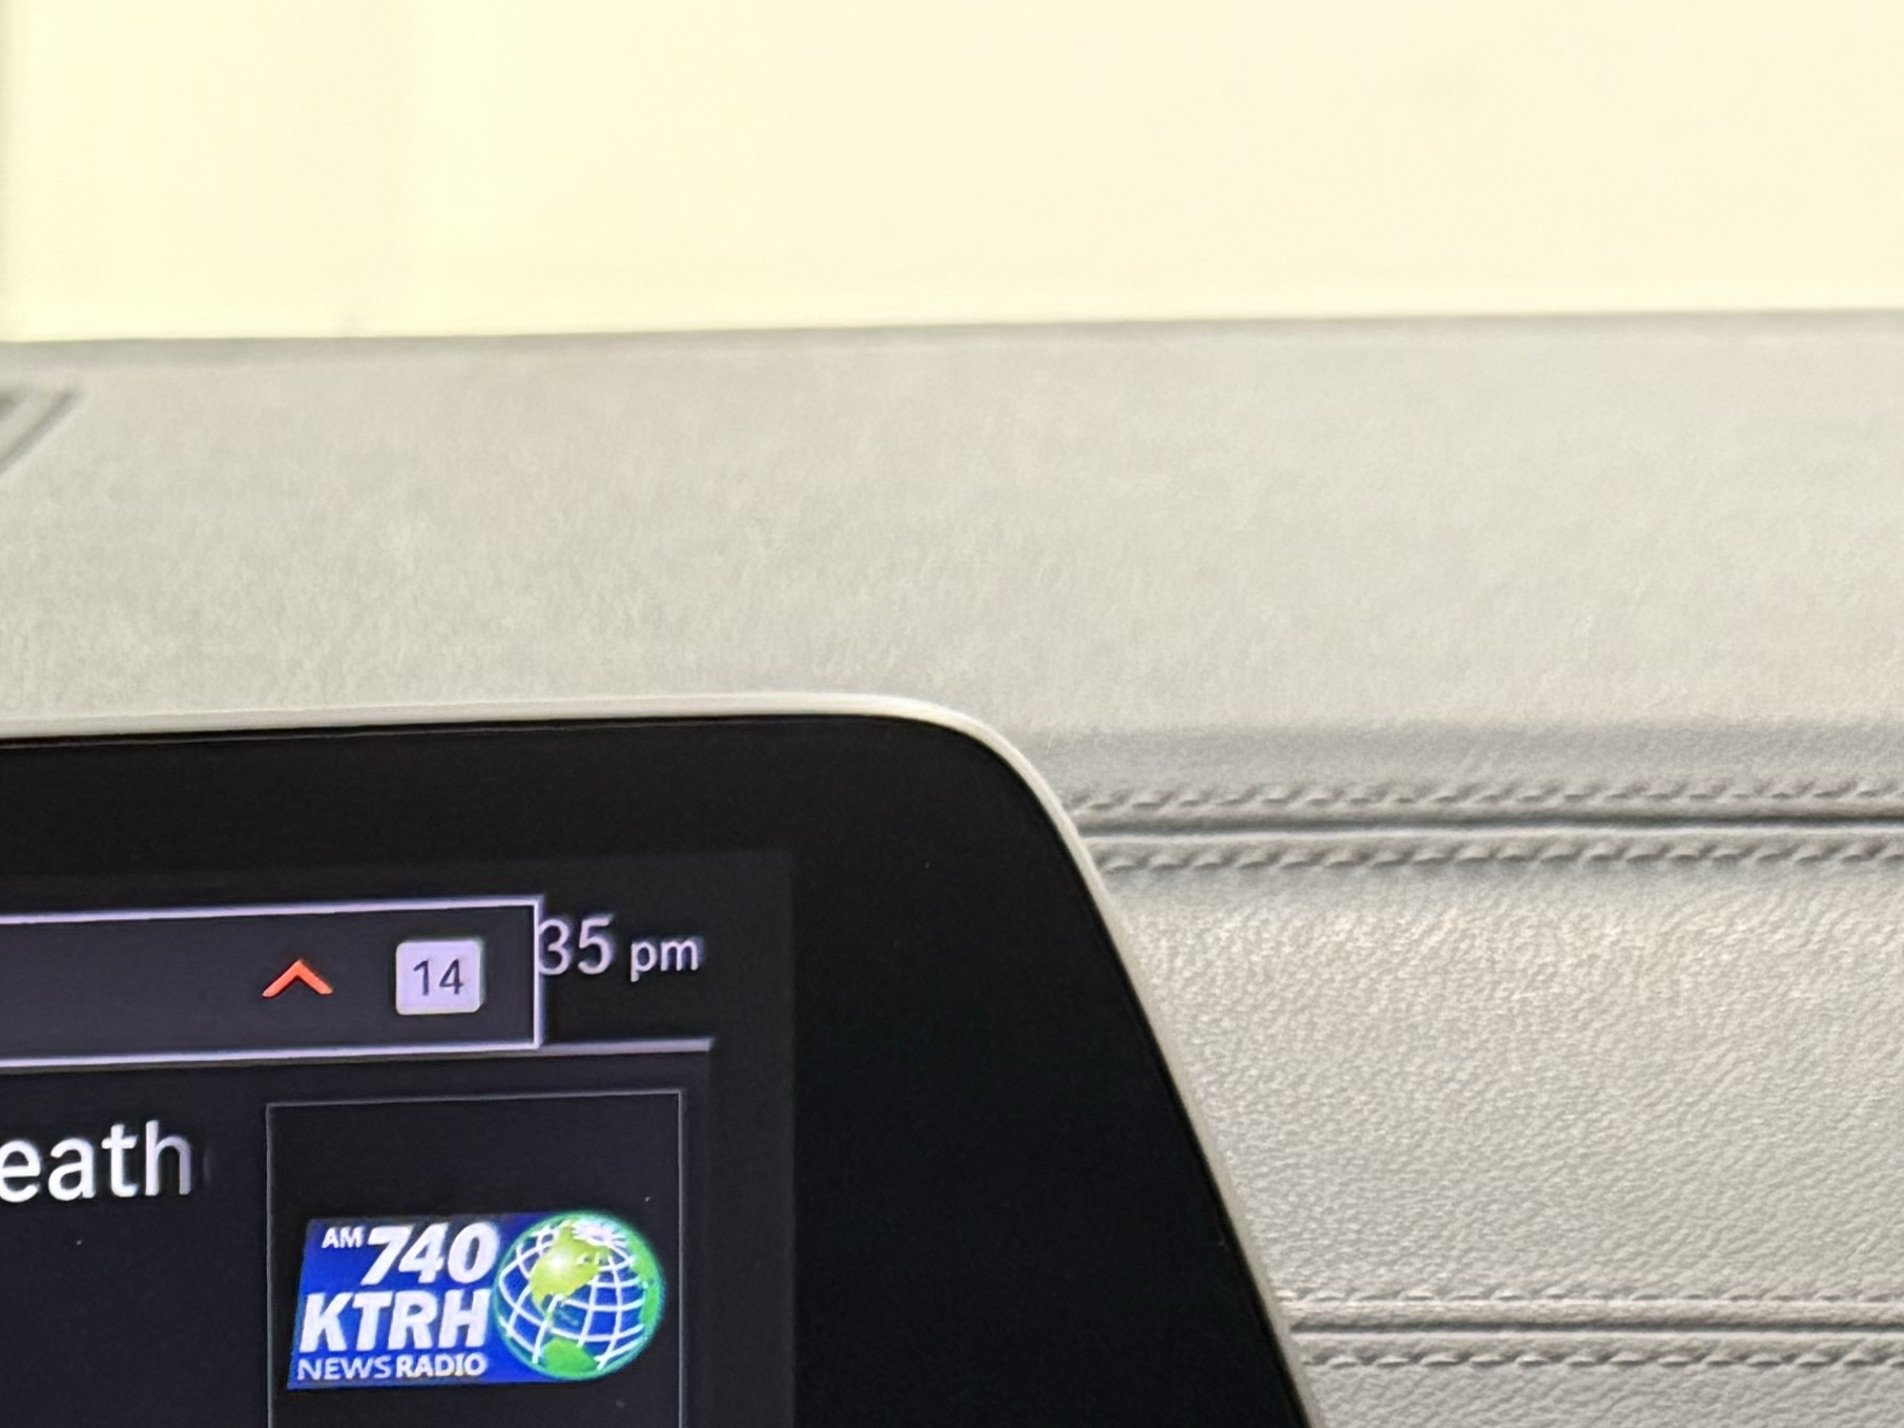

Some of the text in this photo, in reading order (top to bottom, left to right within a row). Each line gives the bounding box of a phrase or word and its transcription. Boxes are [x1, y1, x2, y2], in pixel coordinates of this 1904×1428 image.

[414, 959, 463, 995] 14
[631, 938, 700, 982] pm
[322, 1221, 499, 1286] AM 740
[298, 1288, 493, 1354] KTRH
[298, 1353, 487, 1380] NEWS RADIO
